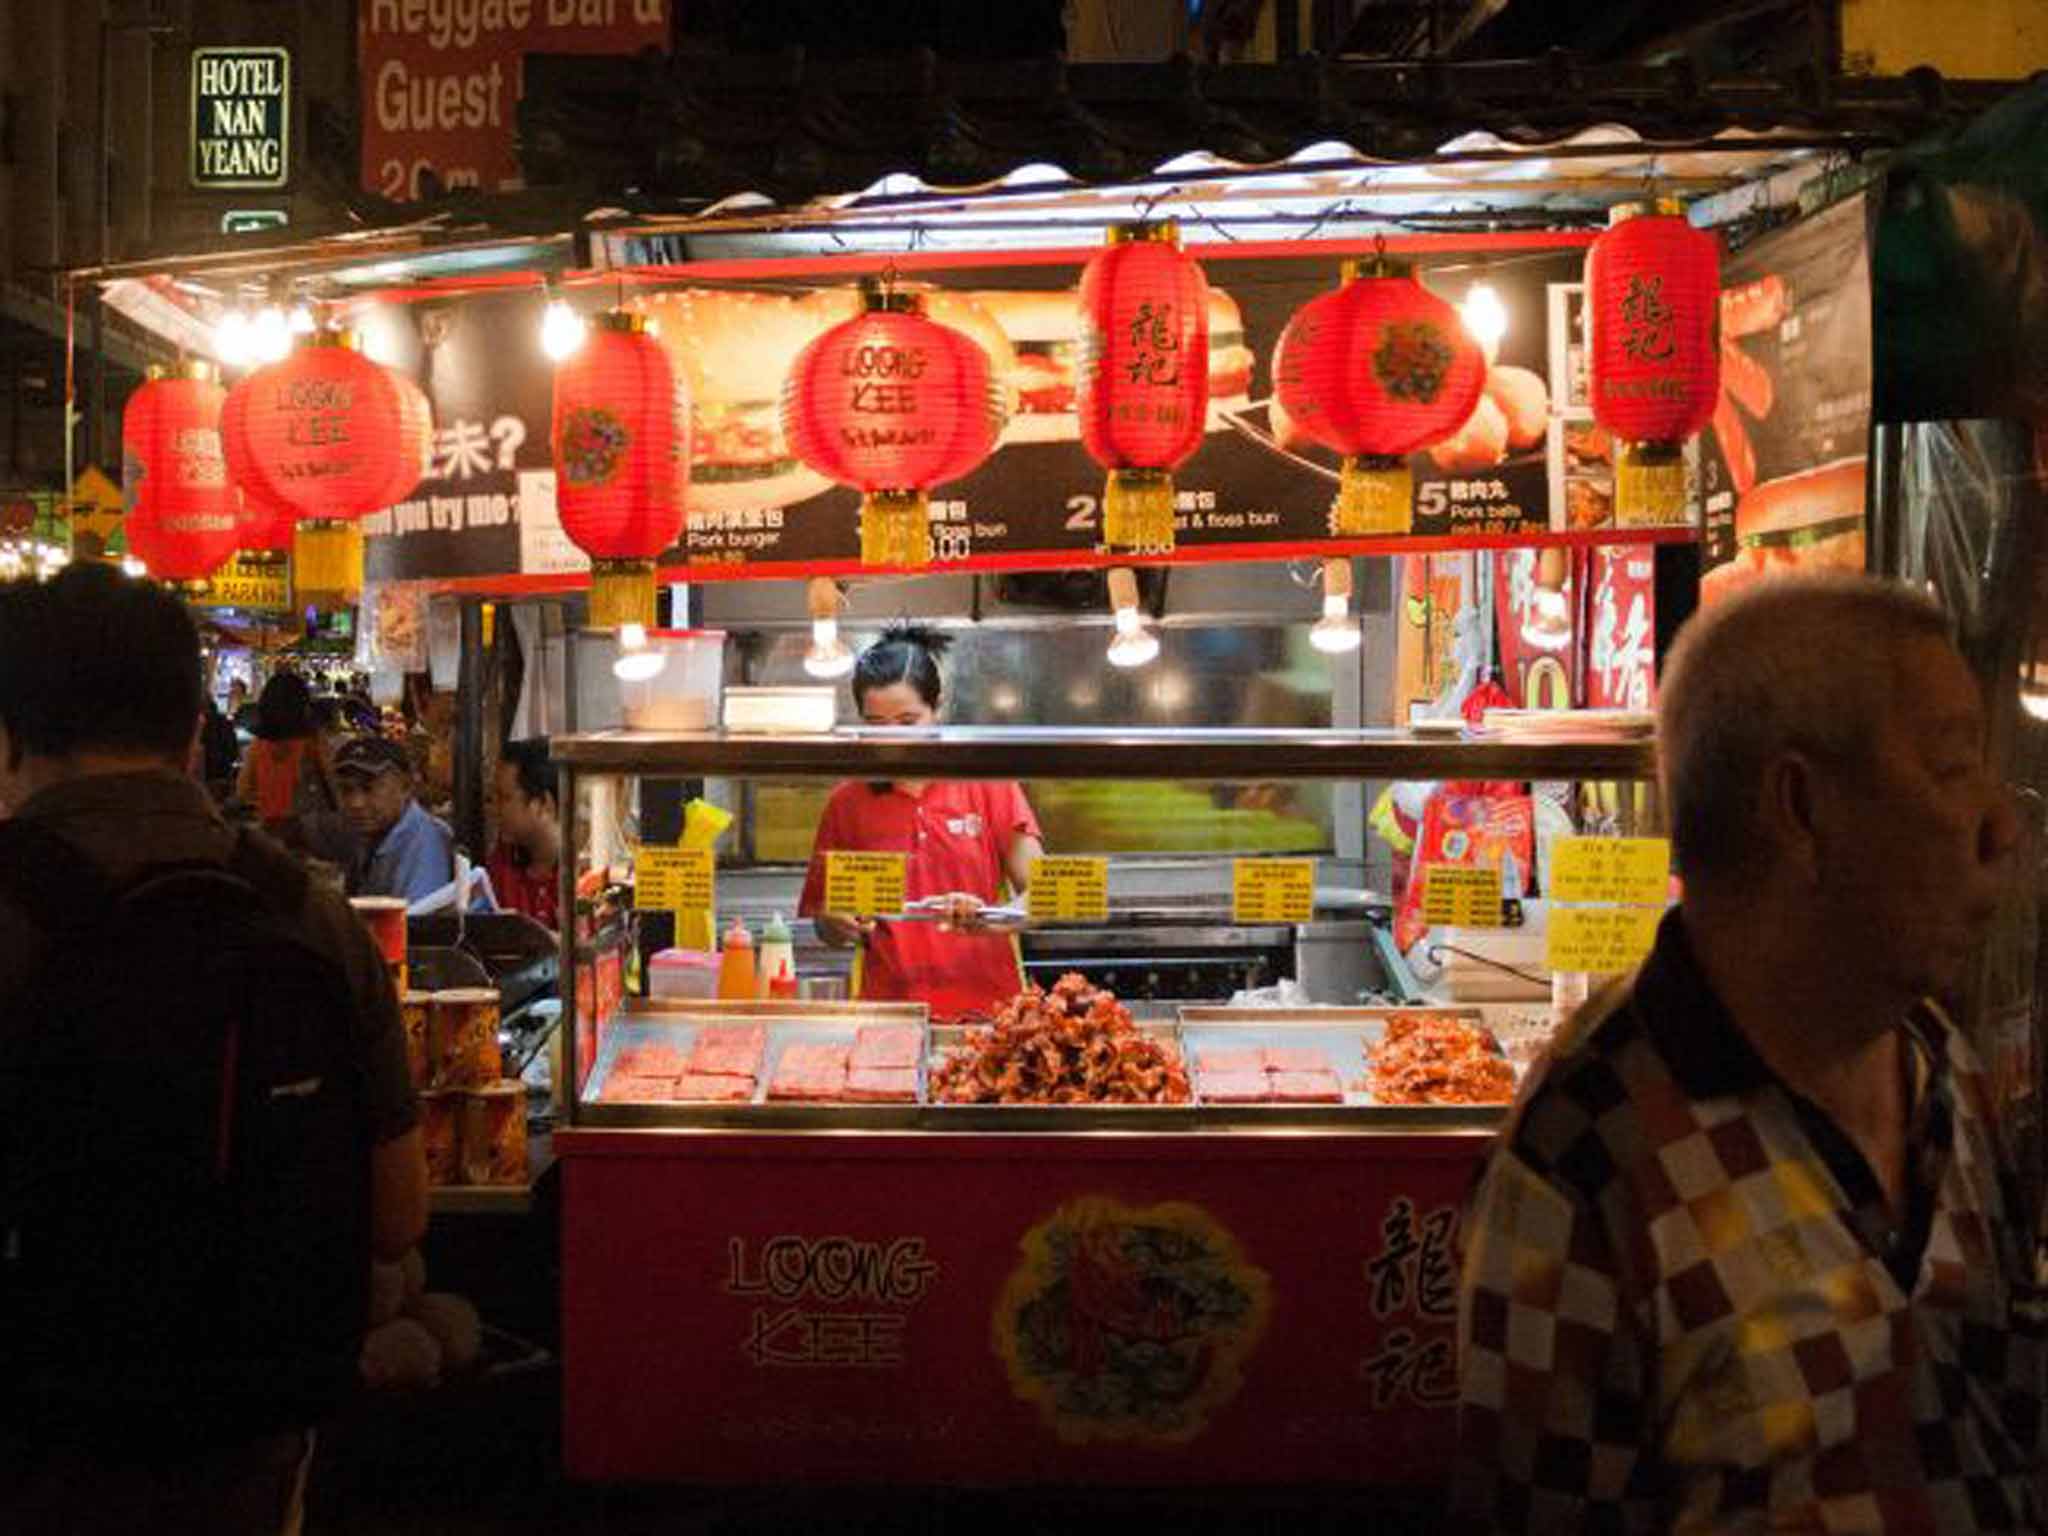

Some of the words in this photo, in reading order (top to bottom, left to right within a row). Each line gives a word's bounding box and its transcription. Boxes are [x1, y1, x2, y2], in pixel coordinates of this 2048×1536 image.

[200, 58, 282, 96] HOTEL
[376, 60, 503, 132] Guest
[213, 99, 267, 136] NAN
[200, 138, 279, 176] YEANG
[841, 346, 928, 379] LOONG
[851, 381, 919, 415] KEE
[1065, 495, 1098, 531] 2
[1417, 482, 1448, 515] 5
[687, 532, 724, 549] Pork
[728, 532, 781, 550] burger
[728, 1235, 939, 1304] LOONG
[742, 1308, 909, 1368] KEE
